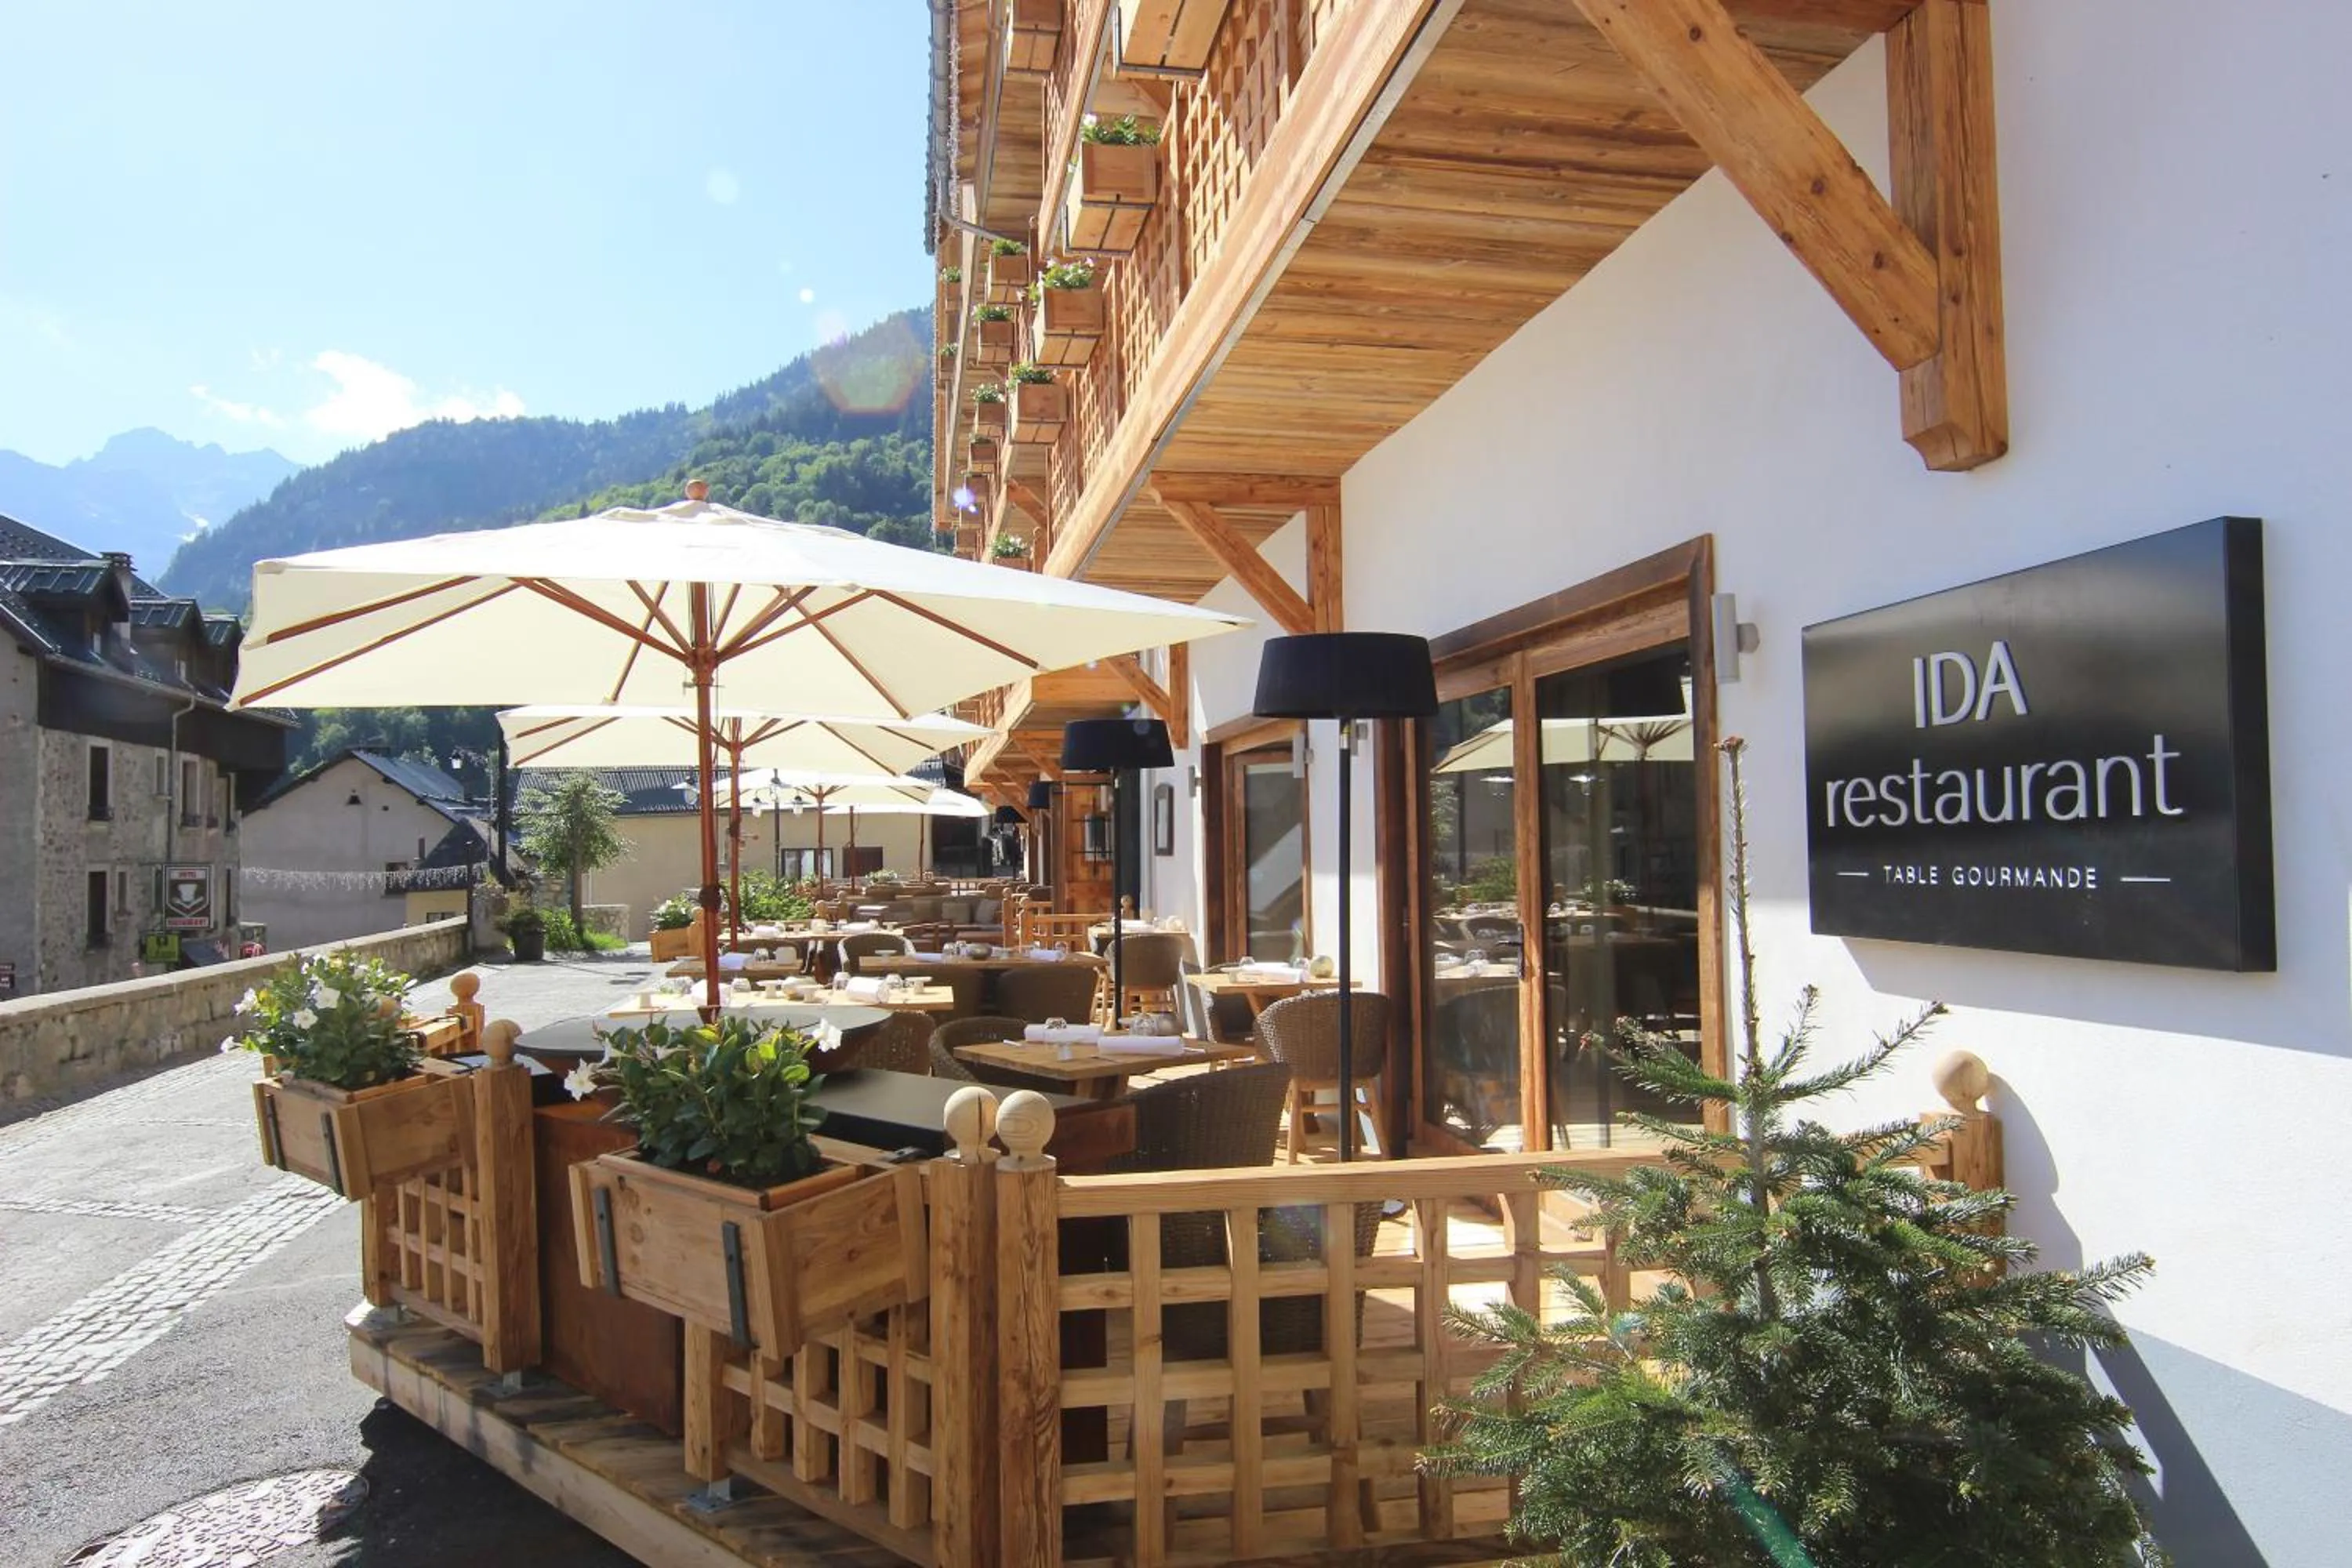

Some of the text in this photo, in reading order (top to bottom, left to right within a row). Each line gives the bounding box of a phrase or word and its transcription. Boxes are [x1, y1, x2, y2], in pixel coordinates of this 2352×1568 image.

[1913, 641, 2027, 728] IDA
[1825, 734, 2183, 828] restaurant
[1883, 866, 2097, 888] TABLE GOURMANDE
